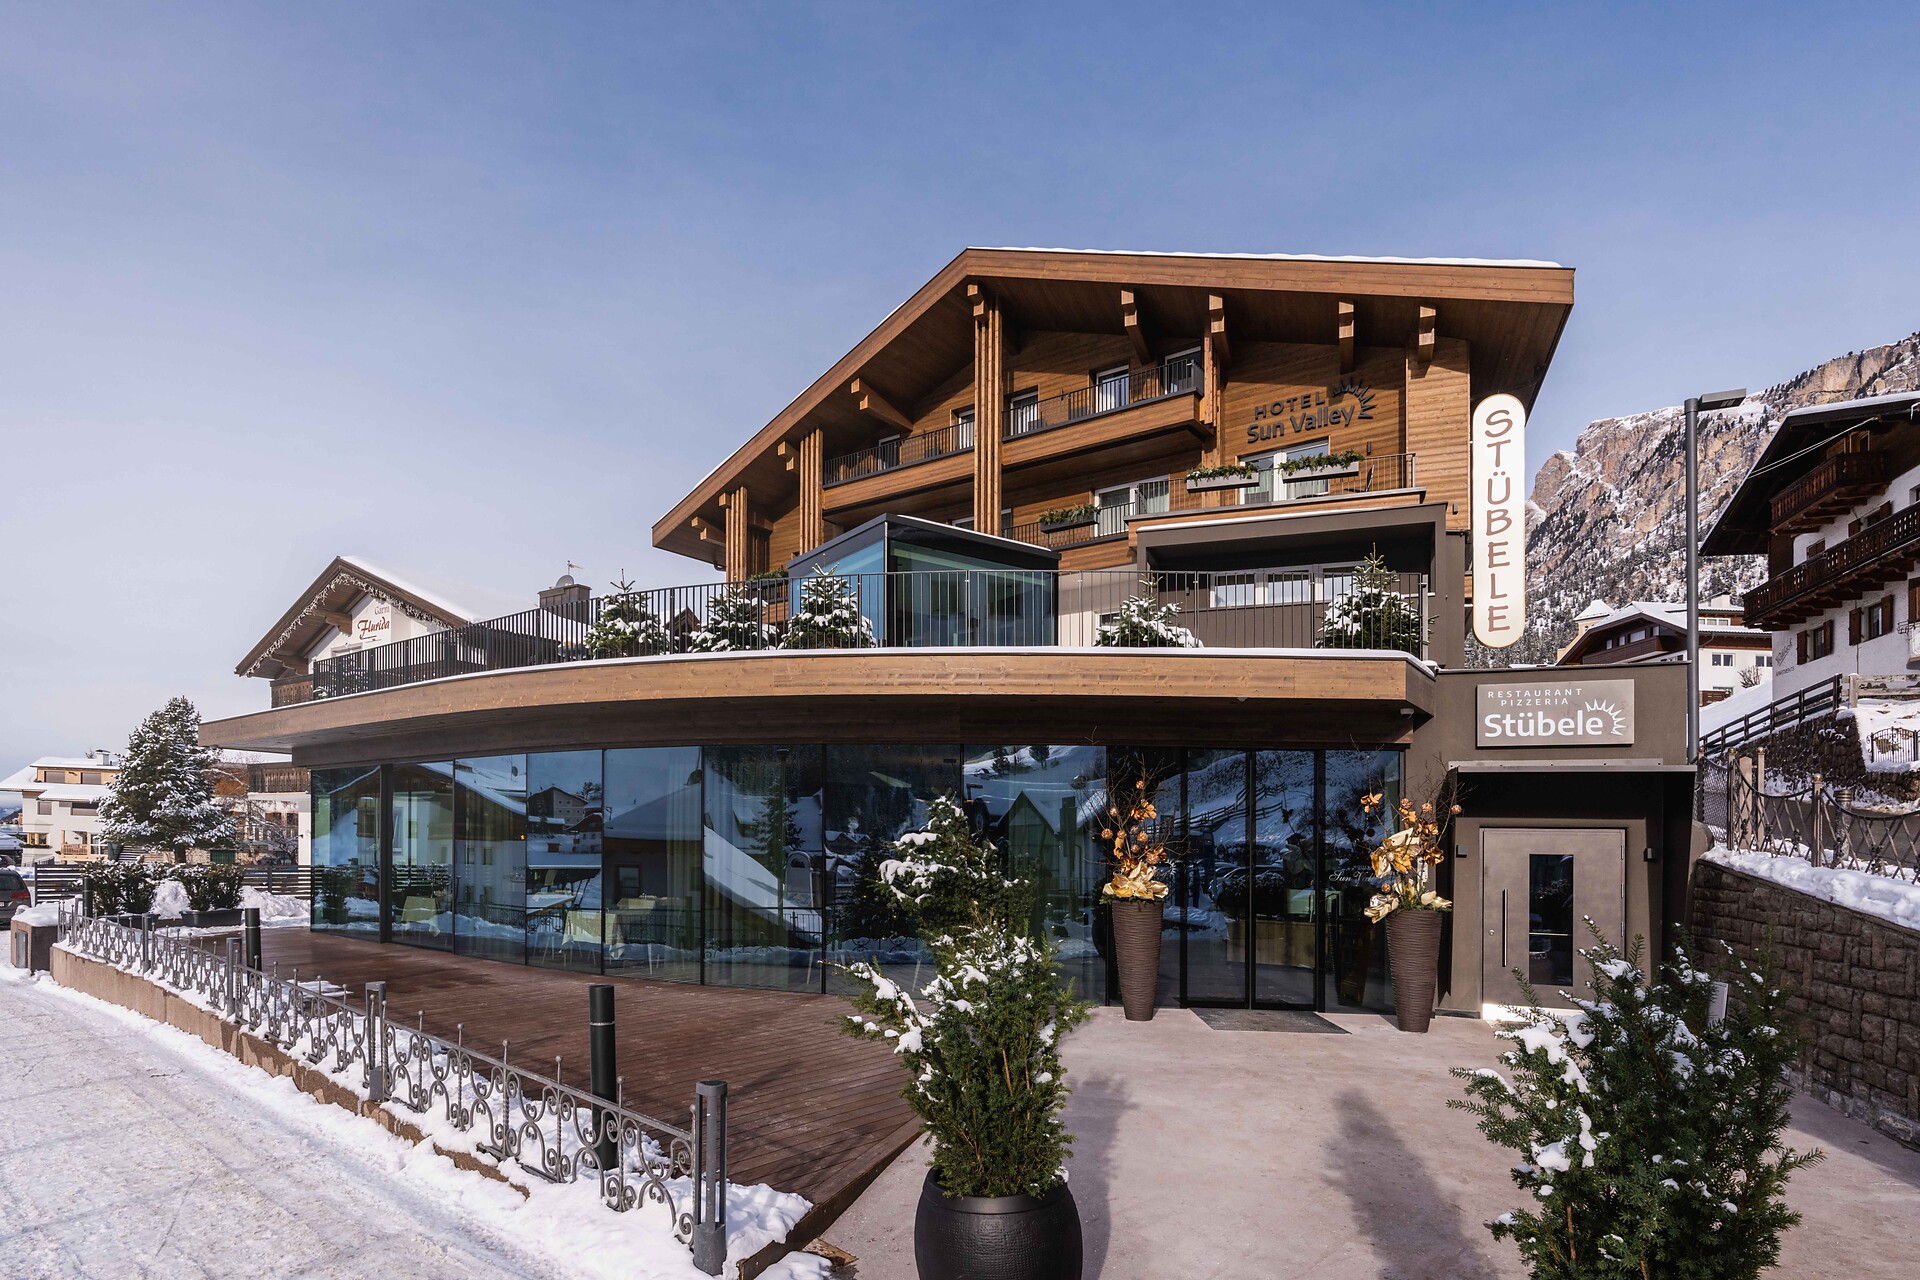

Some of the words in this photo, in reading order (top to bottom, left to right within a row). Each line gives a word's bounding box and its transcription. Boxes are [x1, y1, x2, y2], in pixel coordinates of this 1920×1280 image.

[1255, 391, 1325, 420] HOTEL
[1247, 421, 1285, 443] Sun
[1290, 404, 1355, 433] Valley
[1485, 410, 1513, 632] STÜBELE
[357, 616, 390, 640] Flurida
[1487, 688, 1582, 698] RESTAURANT
[1501, 698, 1569, 706] PIZZERIA
[1484, 710, 1603, 737] Stübele
